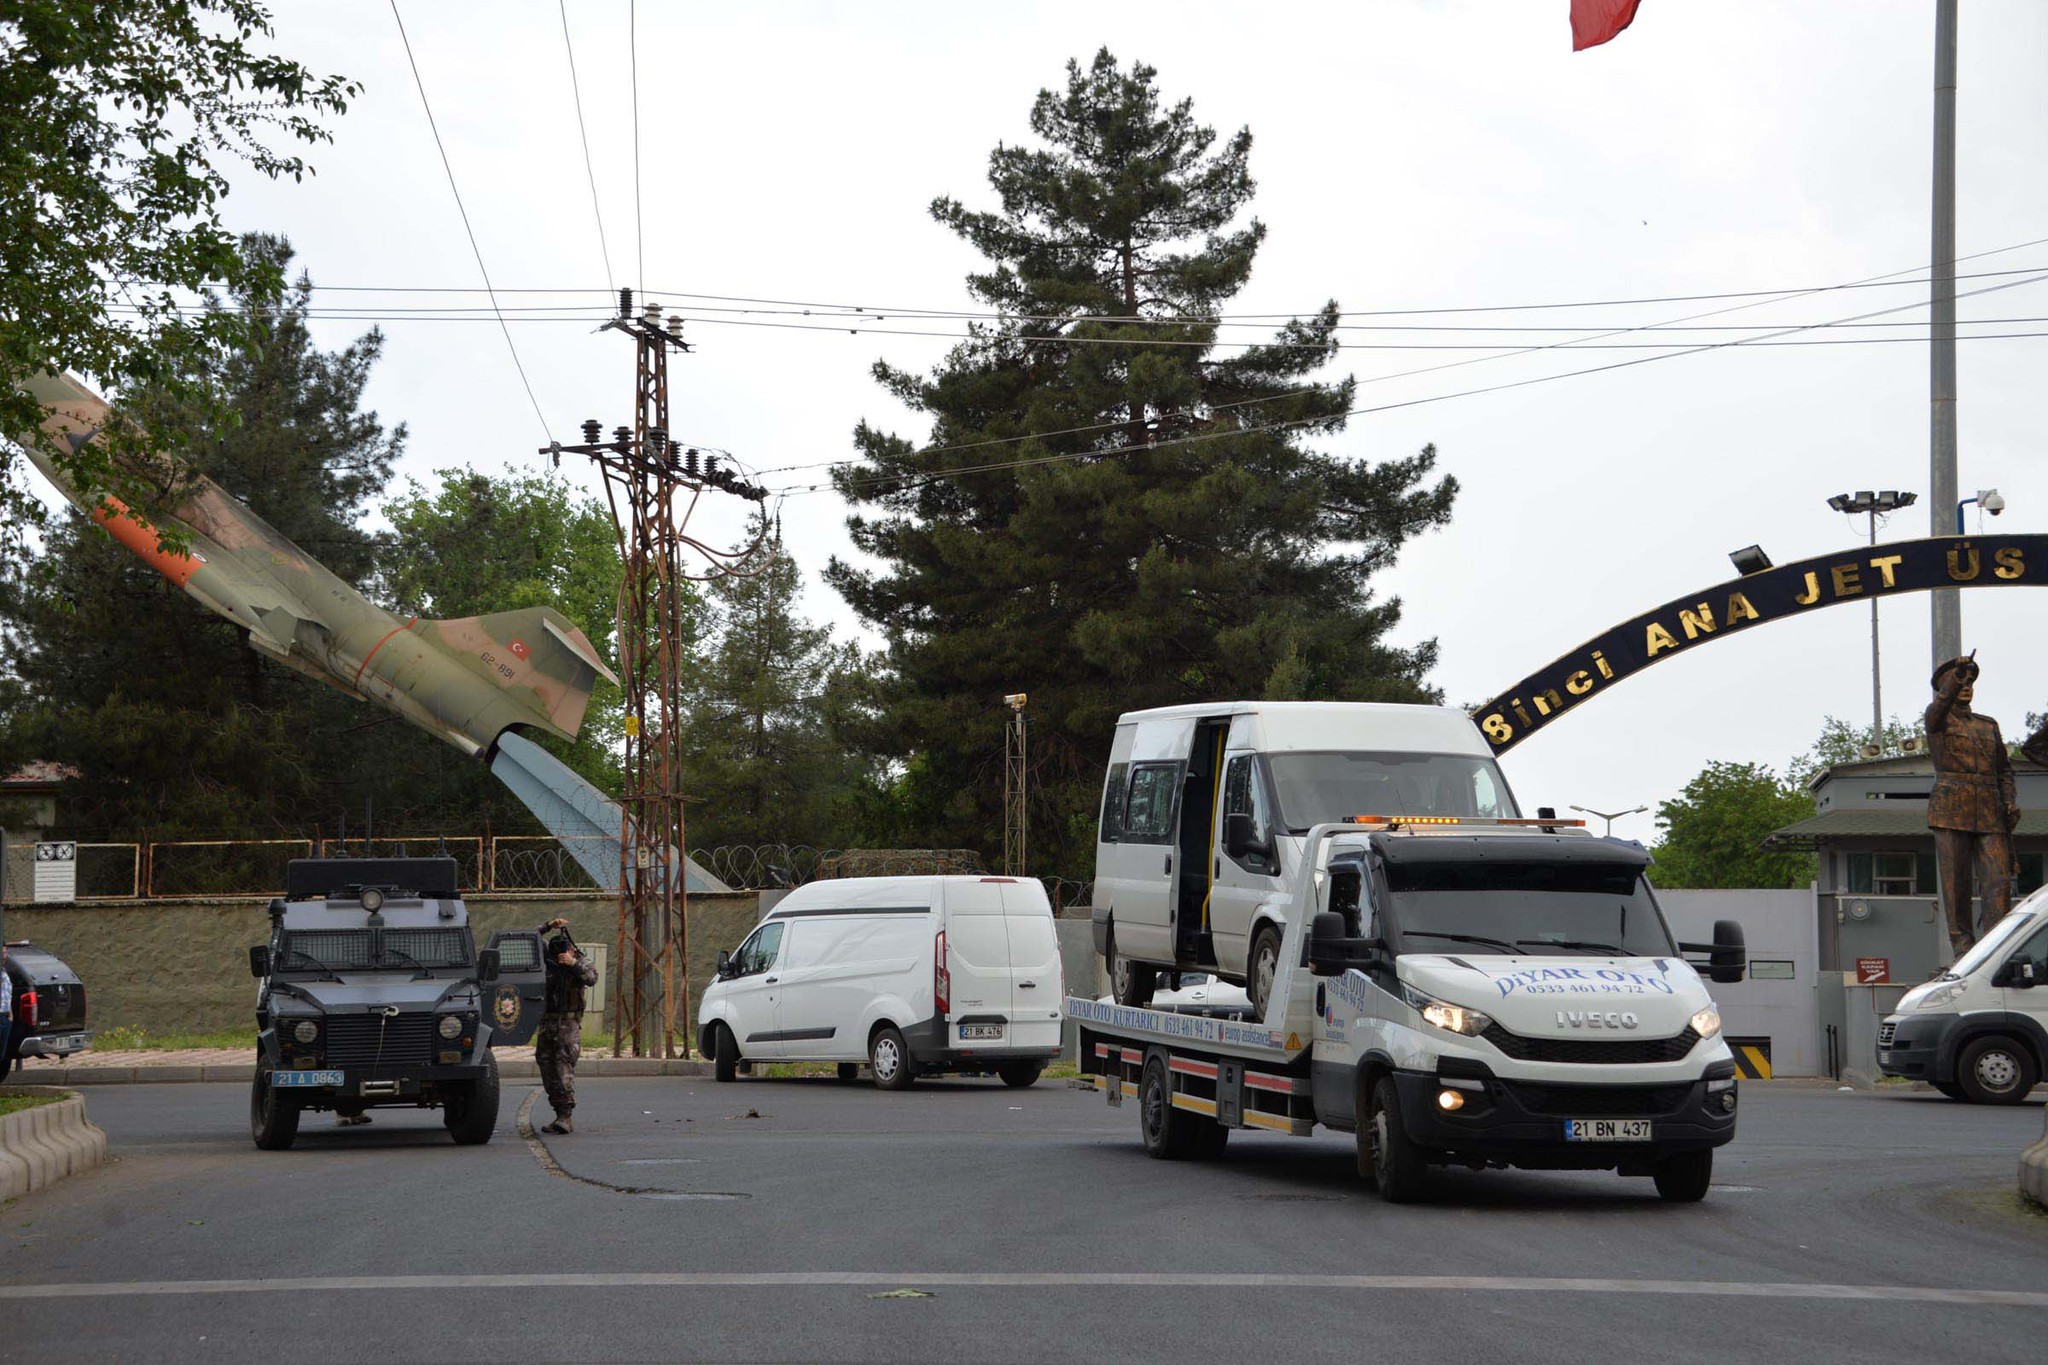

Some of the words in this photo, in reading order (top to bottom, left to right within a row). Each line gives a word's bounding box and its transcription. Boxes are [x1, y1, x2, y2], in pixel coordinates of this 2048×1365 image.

[1646, 592, 1760, 657] ANA
[1795, 555, 1902, 605] JET
[1946, 541, 2026, 581] ÜS
[1526, 984, 1565, 994] 0533
[1570, 984, 1595, 994] 461
[1602, 984, 1621, 994] 94
[1625, 984, 1645, 994] 72
[1596, 969, 1674, 995] OTO
[1093, 1003, 1111, 1022] OTO
[1113, 1008, 1159, 1031] KURTARICI
[1164, 1016, 1180, 1035] 0533
[1181, 1019, 1193, 1037] 461
[1194, 1021, 1203, 1038] 94
[1205, 1021, 1214, 1040] 72
[1555, 1010, 1639, 1030] IVECO
[964, 1028, 973, 1036] 21
[975, 1028, 985, 1036] BK
[1225, 1026, 1240, 1045] europ
[278, 1073, 292, 1085] 21
[298, 1073, 306, 1084] A
[1573, 1121, 1589, 1137] 21
[1595, 1121, 1616, 1137] BN
[1622, 1121, 1650, 1137] 437
